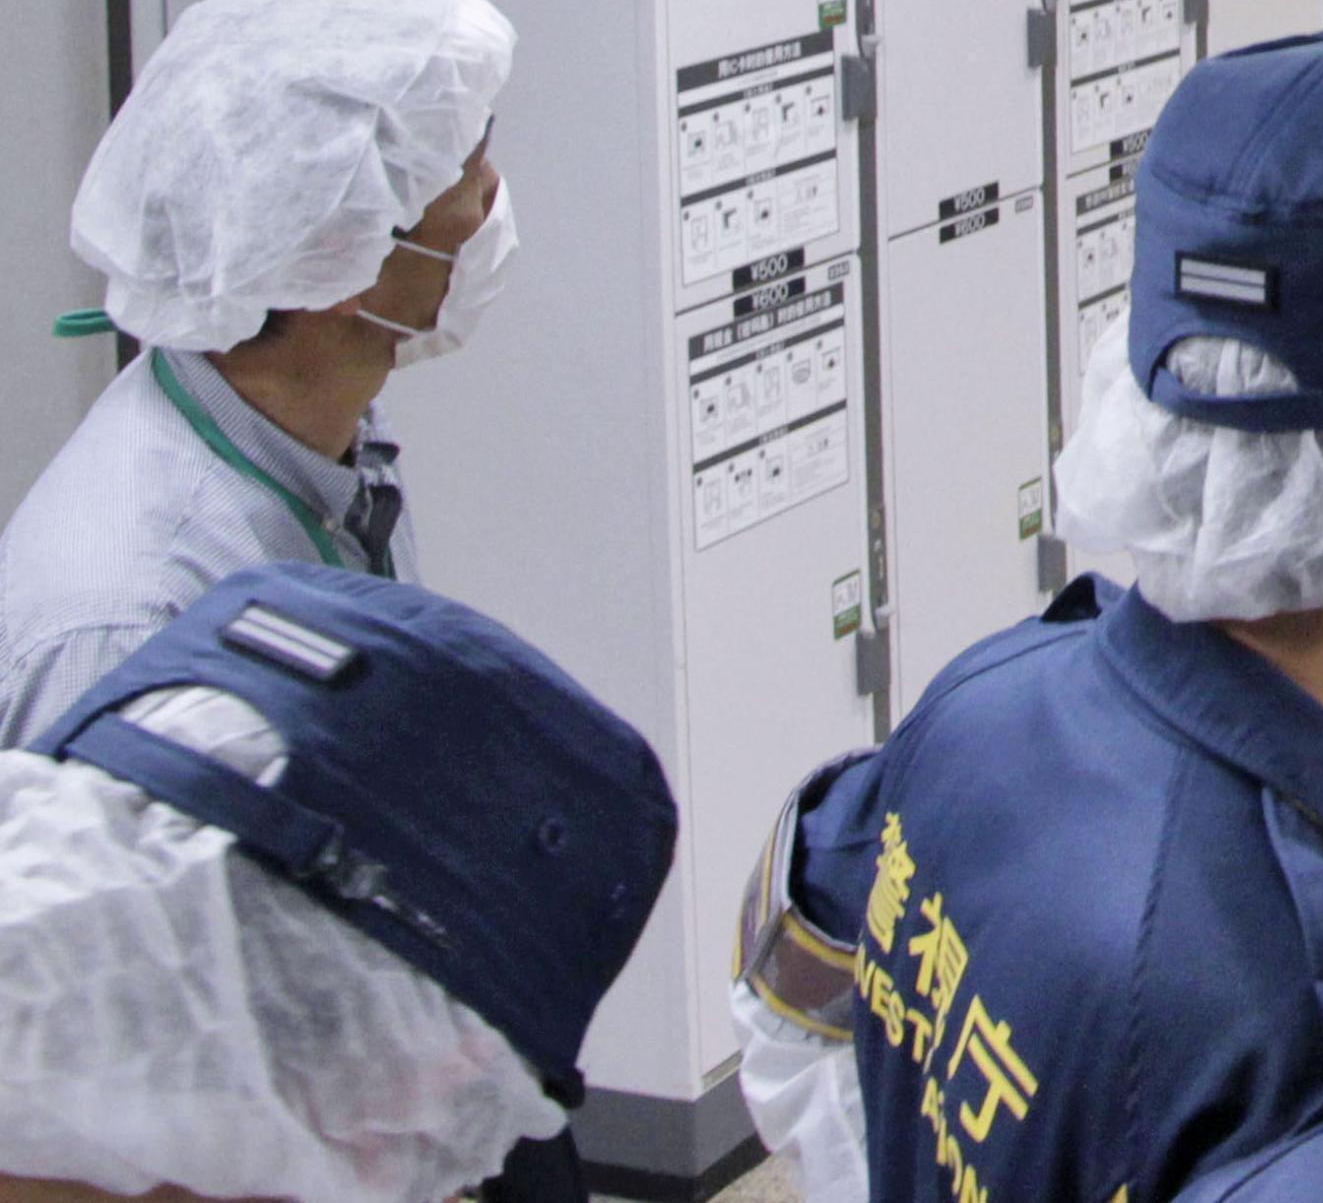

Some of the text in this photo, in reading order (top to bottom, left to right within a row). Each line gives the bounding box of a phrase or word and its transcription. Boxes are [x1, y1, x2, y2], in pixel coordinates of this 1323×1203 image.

[955, 186, 985, 213] ¥500
[750, 253, 789, 281] ¥500
[751, 284, 790, 311] ¥600
[866, 811, 1040, 1143] 警視庁
